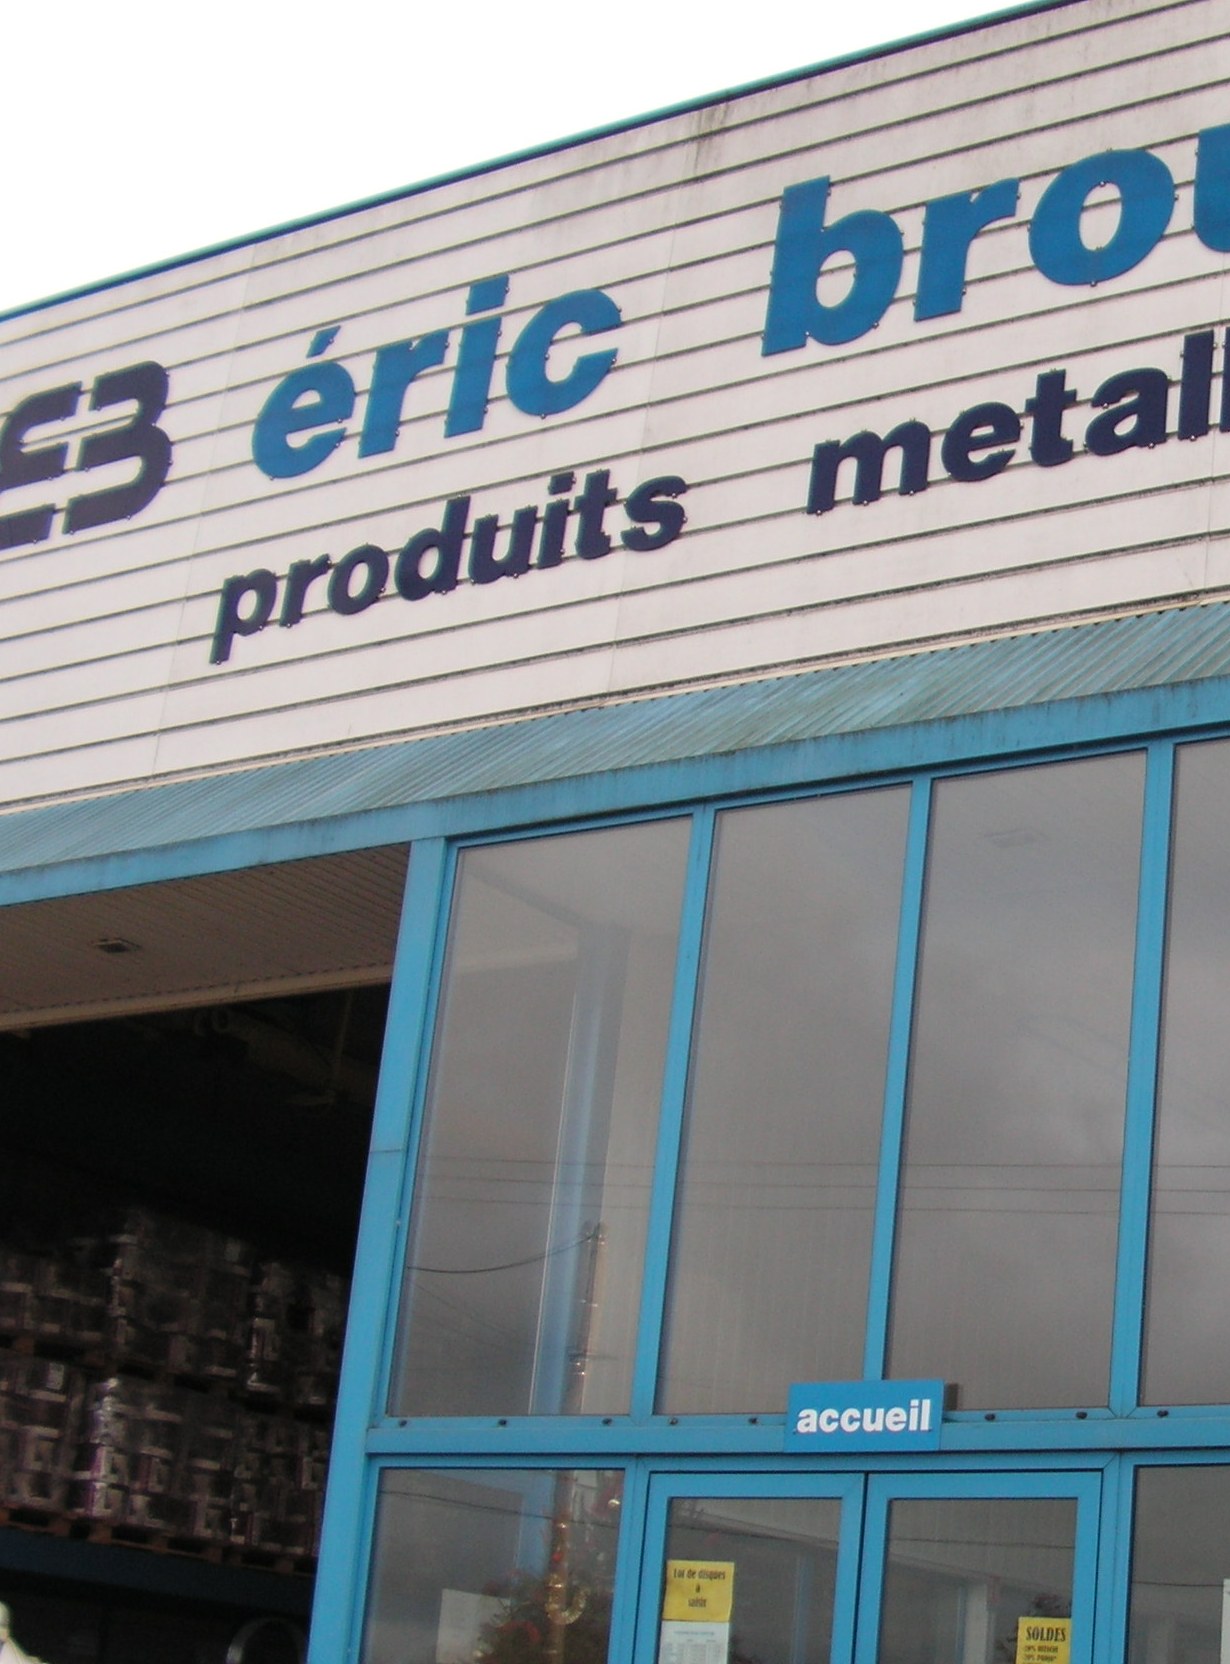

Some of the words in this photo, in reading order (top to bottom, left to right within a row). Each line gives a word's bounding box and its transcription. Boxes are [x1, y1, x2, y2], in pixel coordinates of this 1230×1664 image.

[251, 273, 622, 479] éric
[209, 469, 688, 665] produits
[796, 1398, 932, 1433] accueil
[686, 1568, 697, 1579] de
[1026, 1625, 1066, 1642] SOLDES
